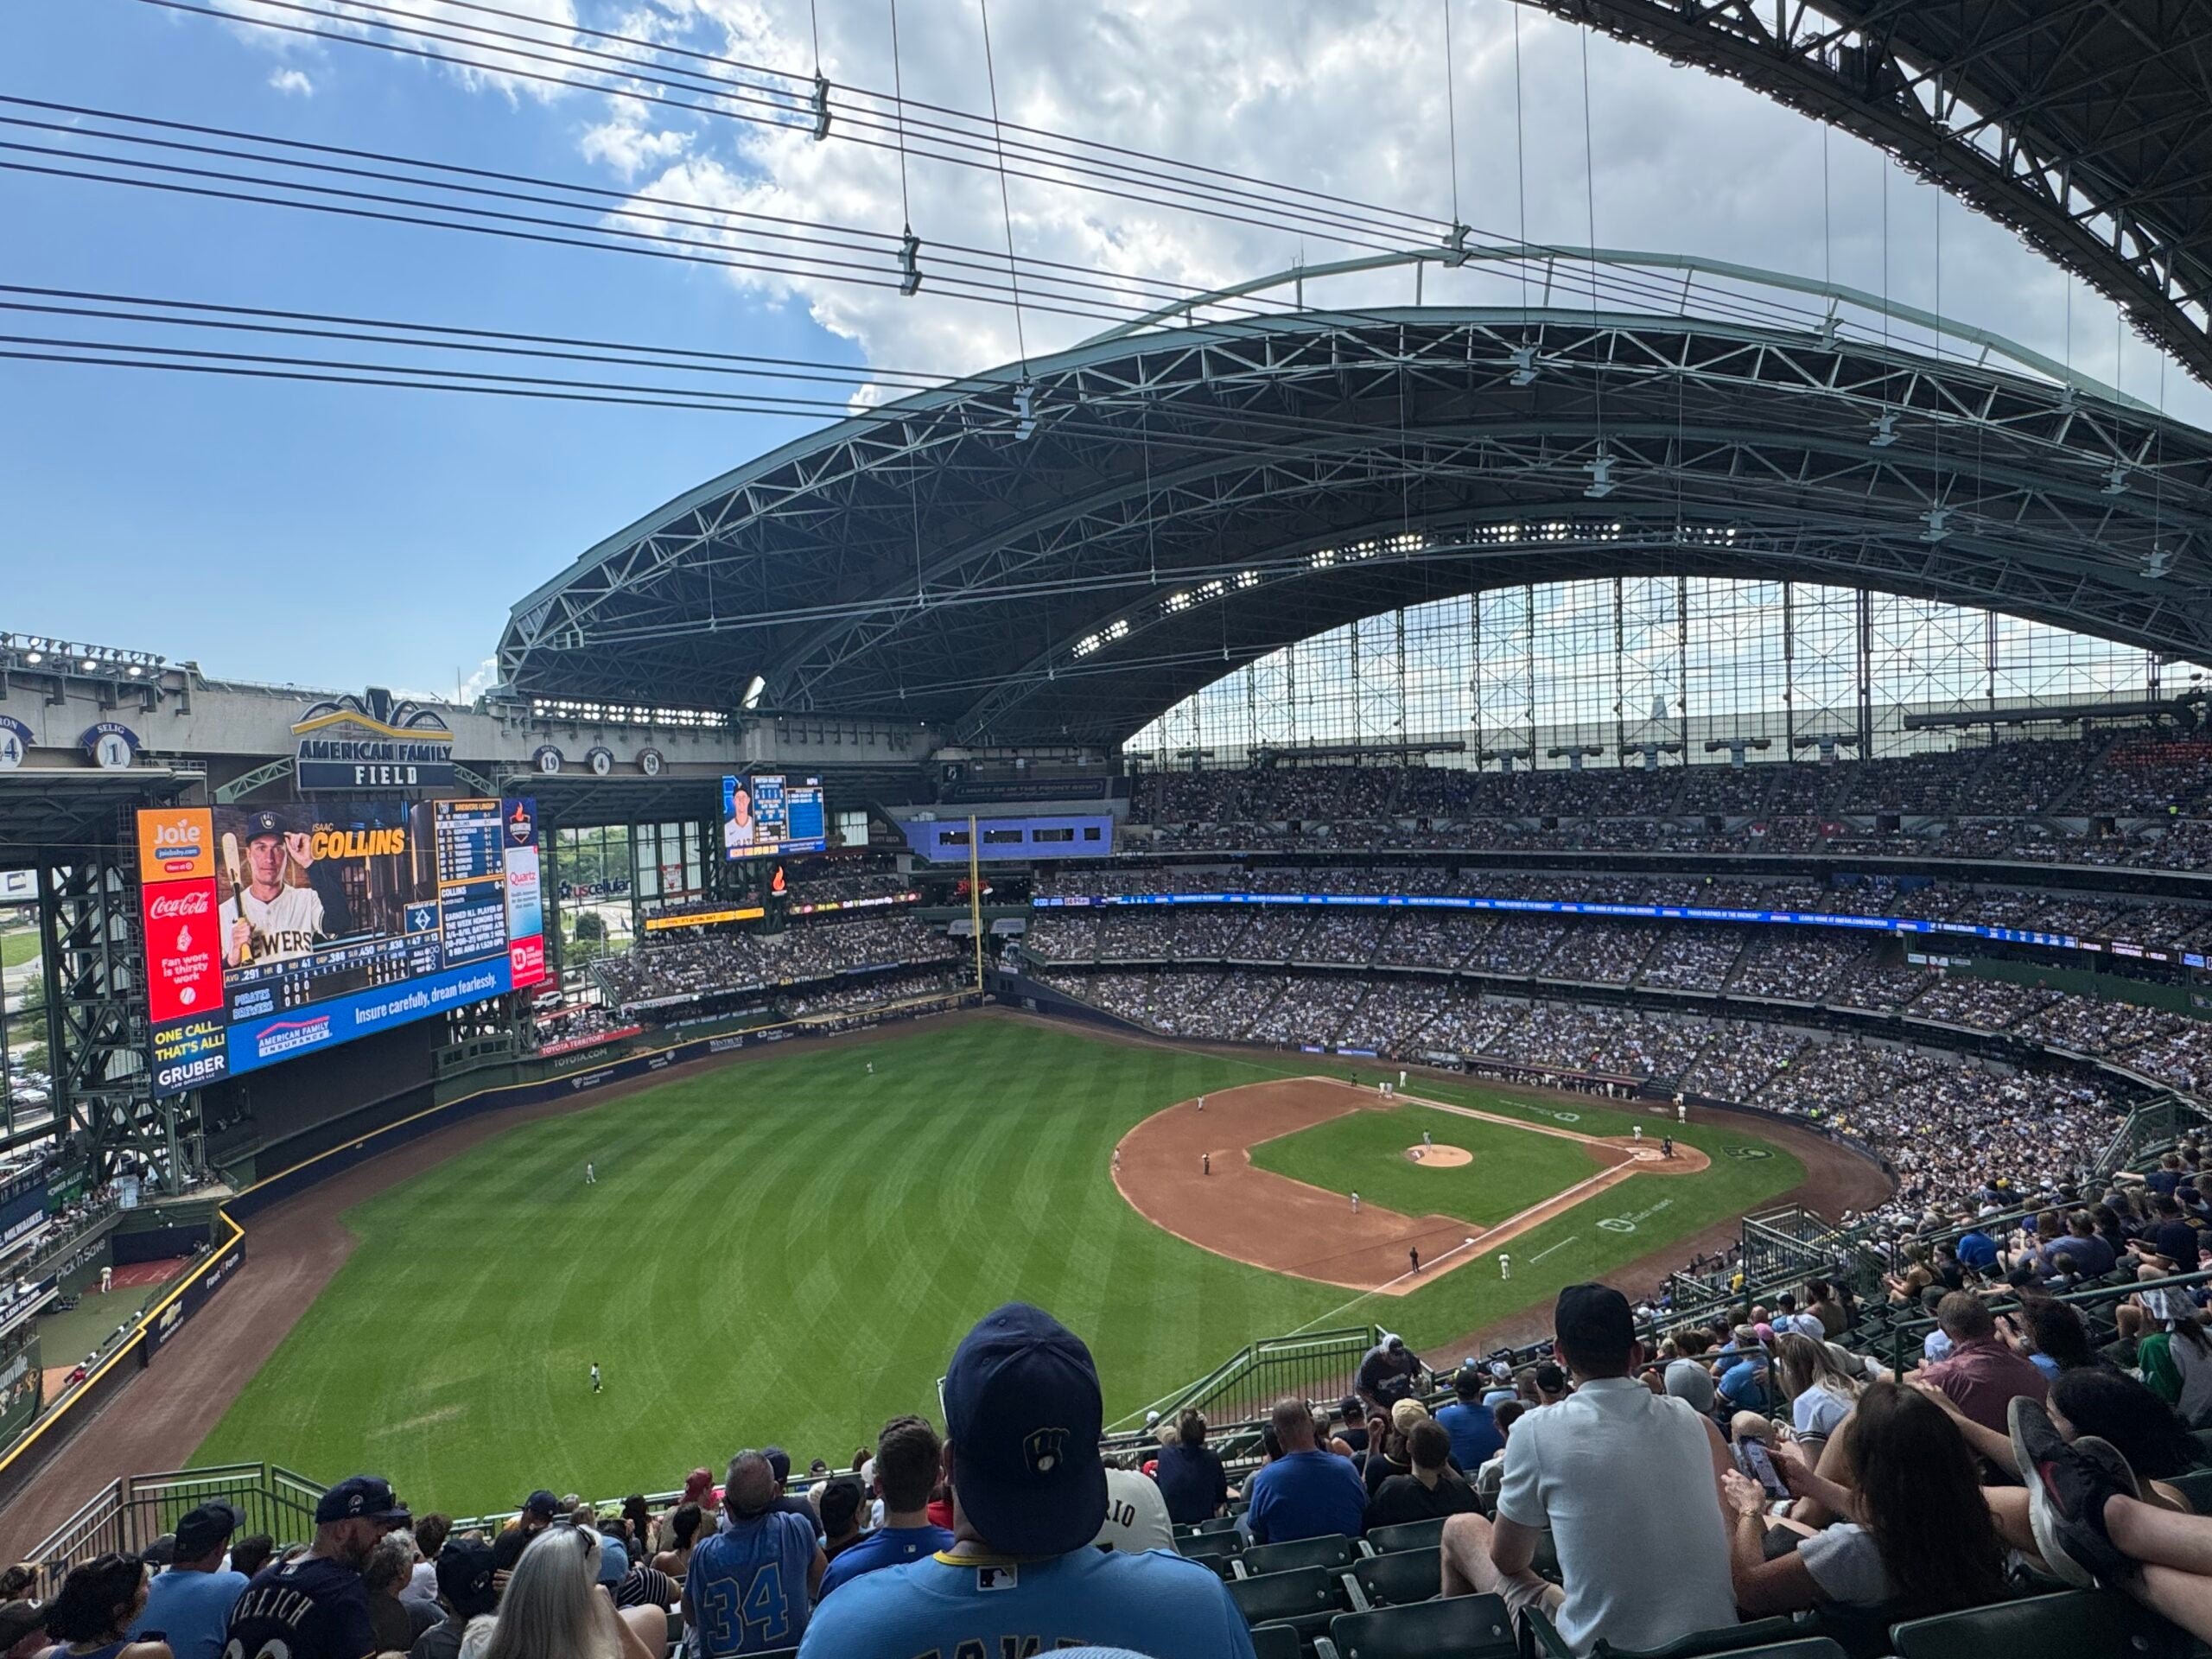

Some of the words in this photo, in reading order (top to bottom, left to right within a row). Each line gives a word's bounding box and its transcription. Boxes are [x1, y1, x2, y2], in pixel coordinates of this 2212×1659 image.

[97, 724, 124, 734] SELIG
[109, 744, 121, 765] 1
[298, 740, 393, 760] AMERICAN
[397, 743, 454, 761] FAMILY
[544, 757, 556, 770] 19
[355, 766, 417, 785] FIELD
[154, 818, 200, 844] Joie
[312, 823, 334, 832] ISAAC
[310, 828, 405, 861] COLLINS
[510, 871, 536, 886] Quartz
[442, 886, 467, 898] COLLINS
[162, 957, 181, 968] Fan
[182, 951, 209, 962] work
[163, 967, 173, 977] is
[175, 962, 208, 975] thirsty
[241, 968, 259, 981] .291
[276, 963, 283, 974] 8
[302, 958, 311, 968] 41
[328, 951, 346, 963] .388
[359, 945, 374, 957] .450
[412, 937, 421, 945] 47
[174, 973, 200, 984] work
[235, 988, 270, 1007] PIRATES
[283, 984, 289, 995] 0
[294, 982, 300, 992] 0
[304, 980, 309, 990] 0
[367, 966, 372, 975] 0
[232, 1000, 274, 1020] BREWERS
[284, 996, 290, 1007] 0
[295, 994, 301, 1004] 0
[305, 992, 309, 1002] 1
[376, 975, 381, 984] 3
[385, 973, 390, 982] 0
[401, 969, 405, 978] 4
[355, 1004, 388, 1025] Insure
[389, 990, 430, 1015] carefully,
[431, 984, 457, 1002] dream
[458, 972, 497, 995] fearlessly.
[154, 1027, 183, 1046] ONE
[259, 1028, 301, 1048] AMERICAN
[302, 1020, 329, 1036] FAMILY
[265, 1032, 324, 1053] INSURANCE
[542, 1041, 569, 1054] TOYOTA
[570, 1033, 606, 1048] TERRITORY
[155, 1040, 199, 1062] THAT'S
[554, 1047, 607, 1068] TOYOTA.COM
[158, 1055, 225, 1086] GRUBER
[67, 1171, 84, 1185] ALLEY
[4, 1210, 44, 1243] MILWAUKEE
[56, 1262, 76, 1282] Pick
[84, 1238, 106, 1262] Save
[207, 1270, 220, 1289] Fleet
[226, 1253, 239, 1270] Farm
[159, 1316, 184, 1343] CHEVROLET
[703, 1561, 789, 1656] 34
